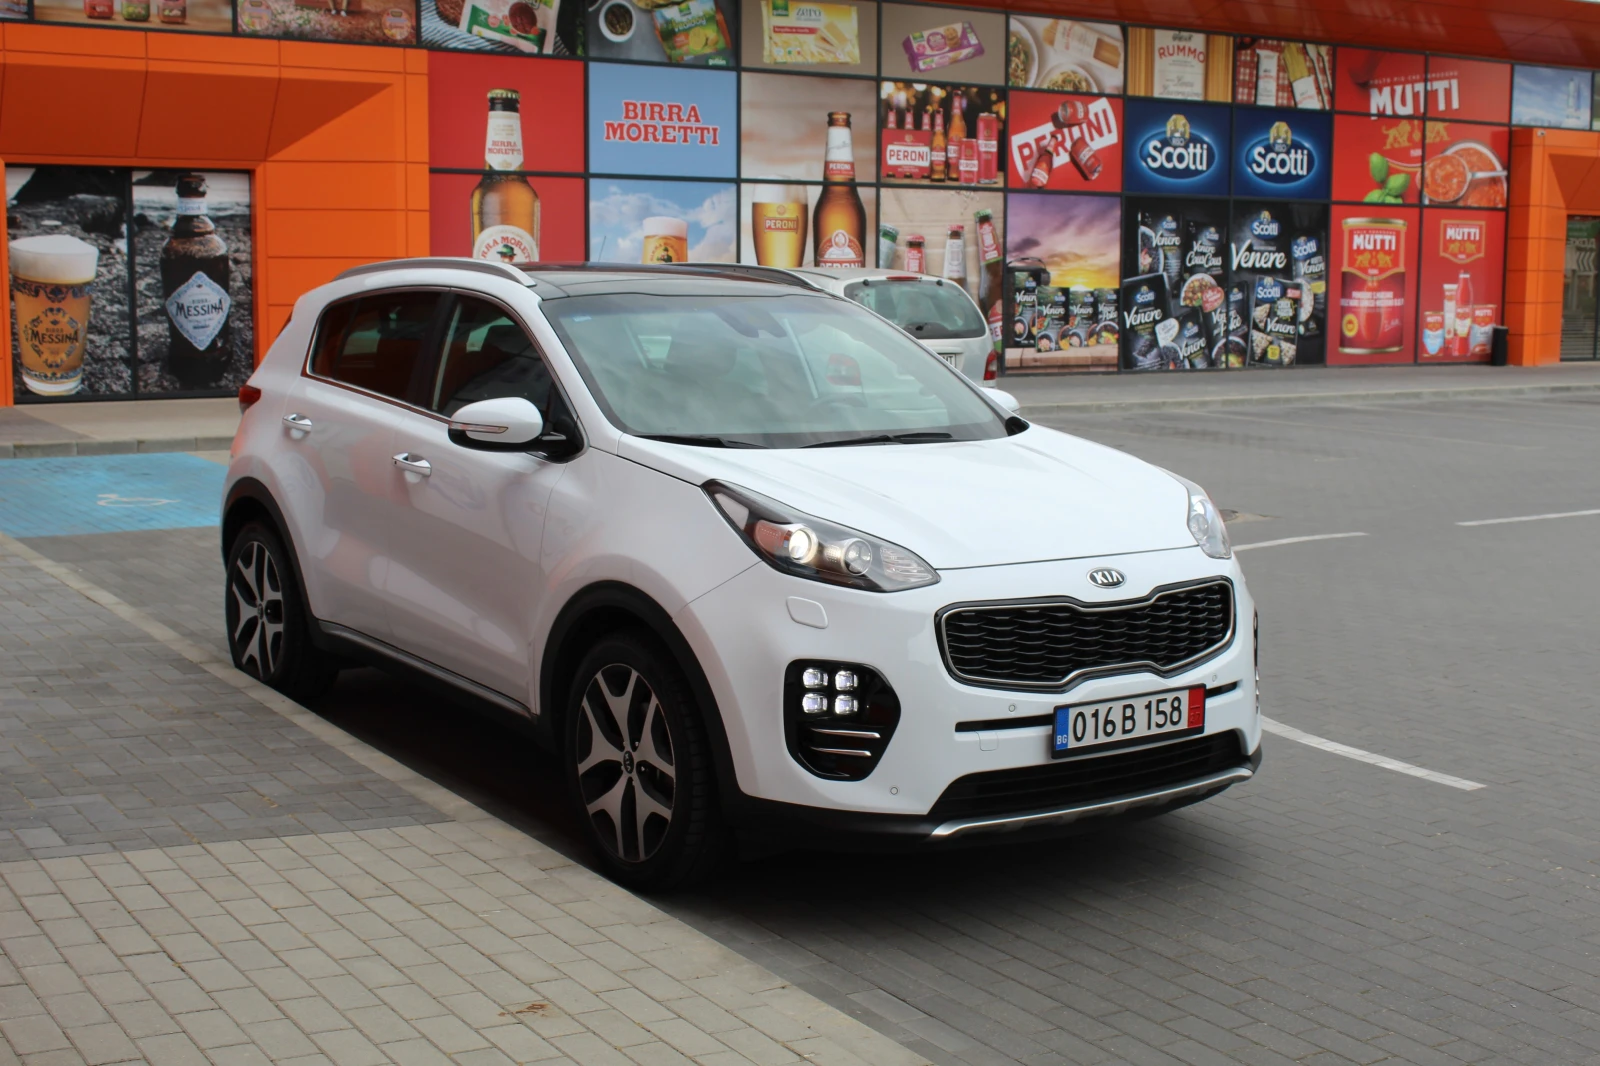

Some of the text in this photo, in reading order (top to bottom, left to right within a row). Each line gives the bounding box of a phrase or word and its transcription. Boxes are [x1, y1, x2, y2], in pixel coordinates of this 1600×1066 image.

[1158, 44, 1206, 64] RUMMO
[1369, 78, 1459, 120] MUTTI
[622, 101, 702, 123] BIRRA
[604, 122, 720, 145] MORETTI
[889, 149, 928, 162] PERONI
[1146, 139, 1208, 171] Scotti
[1252, 146, 1308, 176] Scotti
[765, 219, 797, 229] PERONI
[1252, 221, 1278, 236] Scotti
[1352, 233, 1396, 251] MUTTI
[1445, 227, 1480, 241] MUTTI
[1230, 239, 1287, 271] Venere
[1293, 240, 1317, 258] Scotti
[1256, 286, 1281, 299] Scotti
[174, 298, 224, 319] MESSINA
[1123, 306, 1163, 329] Venere
[29, 328, 79, 345] MESSINA
[1091, 570, 1123, 584] KIA
[1072, 695, 1183, 743] 016 B 158
[1056, 734, 1068, 745] BG
